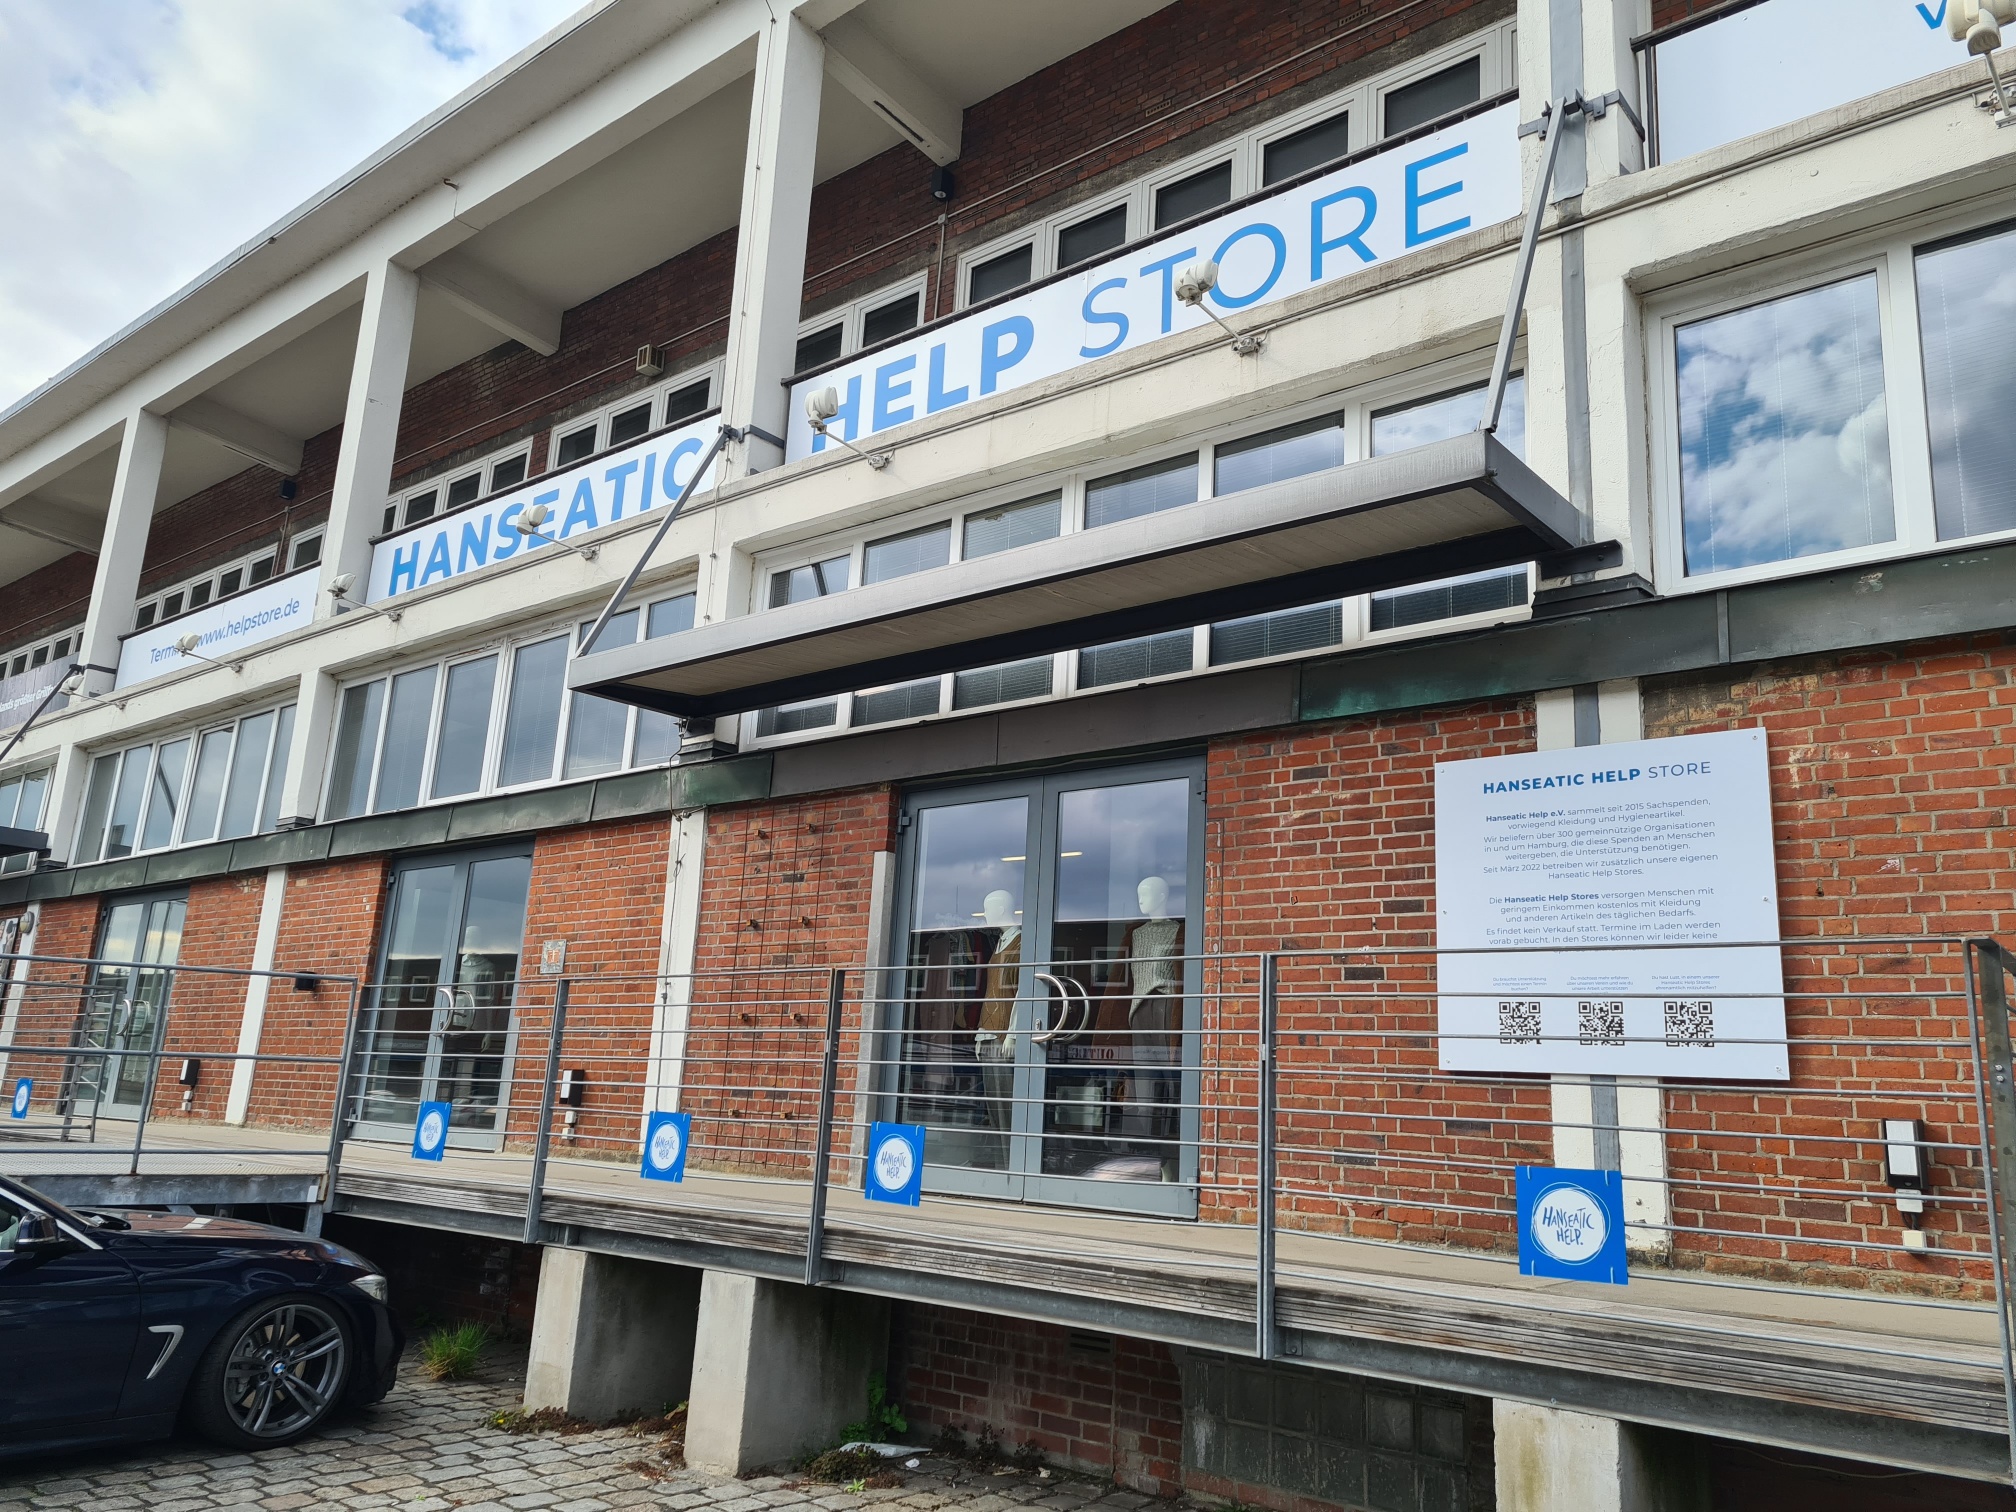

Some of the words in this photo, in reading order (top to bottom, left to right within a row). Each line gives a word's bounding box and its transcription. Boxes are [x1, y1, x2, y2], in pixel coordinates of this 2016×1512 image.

[811, 314, 1034, 453] HELP
[1079, 141, 1472, 359] STORE
[388, 437, 704, 597] HANSEATIC
[196, 597, 300, 648] www.helpstore.de
[1483, 774, 1584, 794] HANSEATIC
[1592, 768, 1640, 784] HELP
[1648, 762, 1711, 778] STORE
[1486, 813, 1526, 822] Hanseatic
[1529, 811, 1548, 819] Help
[1568, 806, 1605, 816] sammelt
[1608, 804, 1623, 812] seit
[1625, 803, 1644, 811] 2015
[1646, 798, 1711, 810] Sachspenden,
[1508, 820, 1555, 830] vorwiegend
[1558, 817, 1595, 827] Kleidung
[1598, 814, 1615, 822] und
[1618, 810, 1685, 823] Hygieneartikel.
[1494, 844, 1509, 852] und
[1528, 841, 1569, 850] Hamburg,
[1571, 839, 1584, 847] die
[1586, 837, 1609, 845] diese
[1611, 835, 1650, 845] Spenden
[1667, 830, 1715, 840] Menschen
[1500, 833, 1534, 842] beliefern
[1537, 831, 1555, 839] über
[1557, 830, 1573, 838] 300
[1575, 826, 1642, 838] gemeinnützige
[1644, 820, 1715, 832] Organisationen
[1505, 850, 1559, 861] weitergeben,
[1561, 849, 1573, 857] die
[1576, 845, 1638, 856] Unterstützung
[1642, 842, 1690, 852] benötigen.
[1500, 864, 1519, 872] März
[1543, 861, 1583, 870] betreiben
[1601, 857, 1644, 867] zusätzlich
[1647, 855, 1677, 864] unsere
[1680, 853, 1718, 864] eigenen
[1549, 870, 1589, 879] Hanseatic
[1592, 869, 1612, 878] Help
[1505, 895, 1546, 903] Hanseatic
[1549, 894, 1568, 903] Help
[1571, 893, 1599, 901] Stores
[1601, 890, 1645, 900] versorgen
[1648, 888, 1695, 897] Menschen
[1501, 905, 1540, 915] geringem
[1543, 903, 1595, 912] Einkommen
[1597, 901, 1638, 909] kostenlos
[1659, 899, 1700, 908] Kleidung
[1524, 913, 1558, 922] anderen
[1561, 912, 1594, 920] Artikeln
[1596, 911, 1611, 919] des
[1614, 909, 1656, 920] täglichen
[1659, 909, 1696, 917] Bedarfs.
[1497, 927, 1521, 935] findet
[1543, 925, 1575, 933] Verkauf
[1577, 924, 1598, 932] statt.
[1600, 923, 1637, 931] Termine
[1654, 922, 1682, 930] Laden
[1685, 921, 1720, 929] werden
[1489, 937, 1511, 945] vorab
[1514, 935, 1550, 946] gebucht.
[1582, 933, 1608, 942] Stores
[1611, 932, 1644, 941] können
[1647, 932, 1661, 940] wir
[1663, 931, 1689, 940] leider
[1692, 931, 1718, 939] keine
[1542, 1206, 1595, 1229] HANSEATIC
